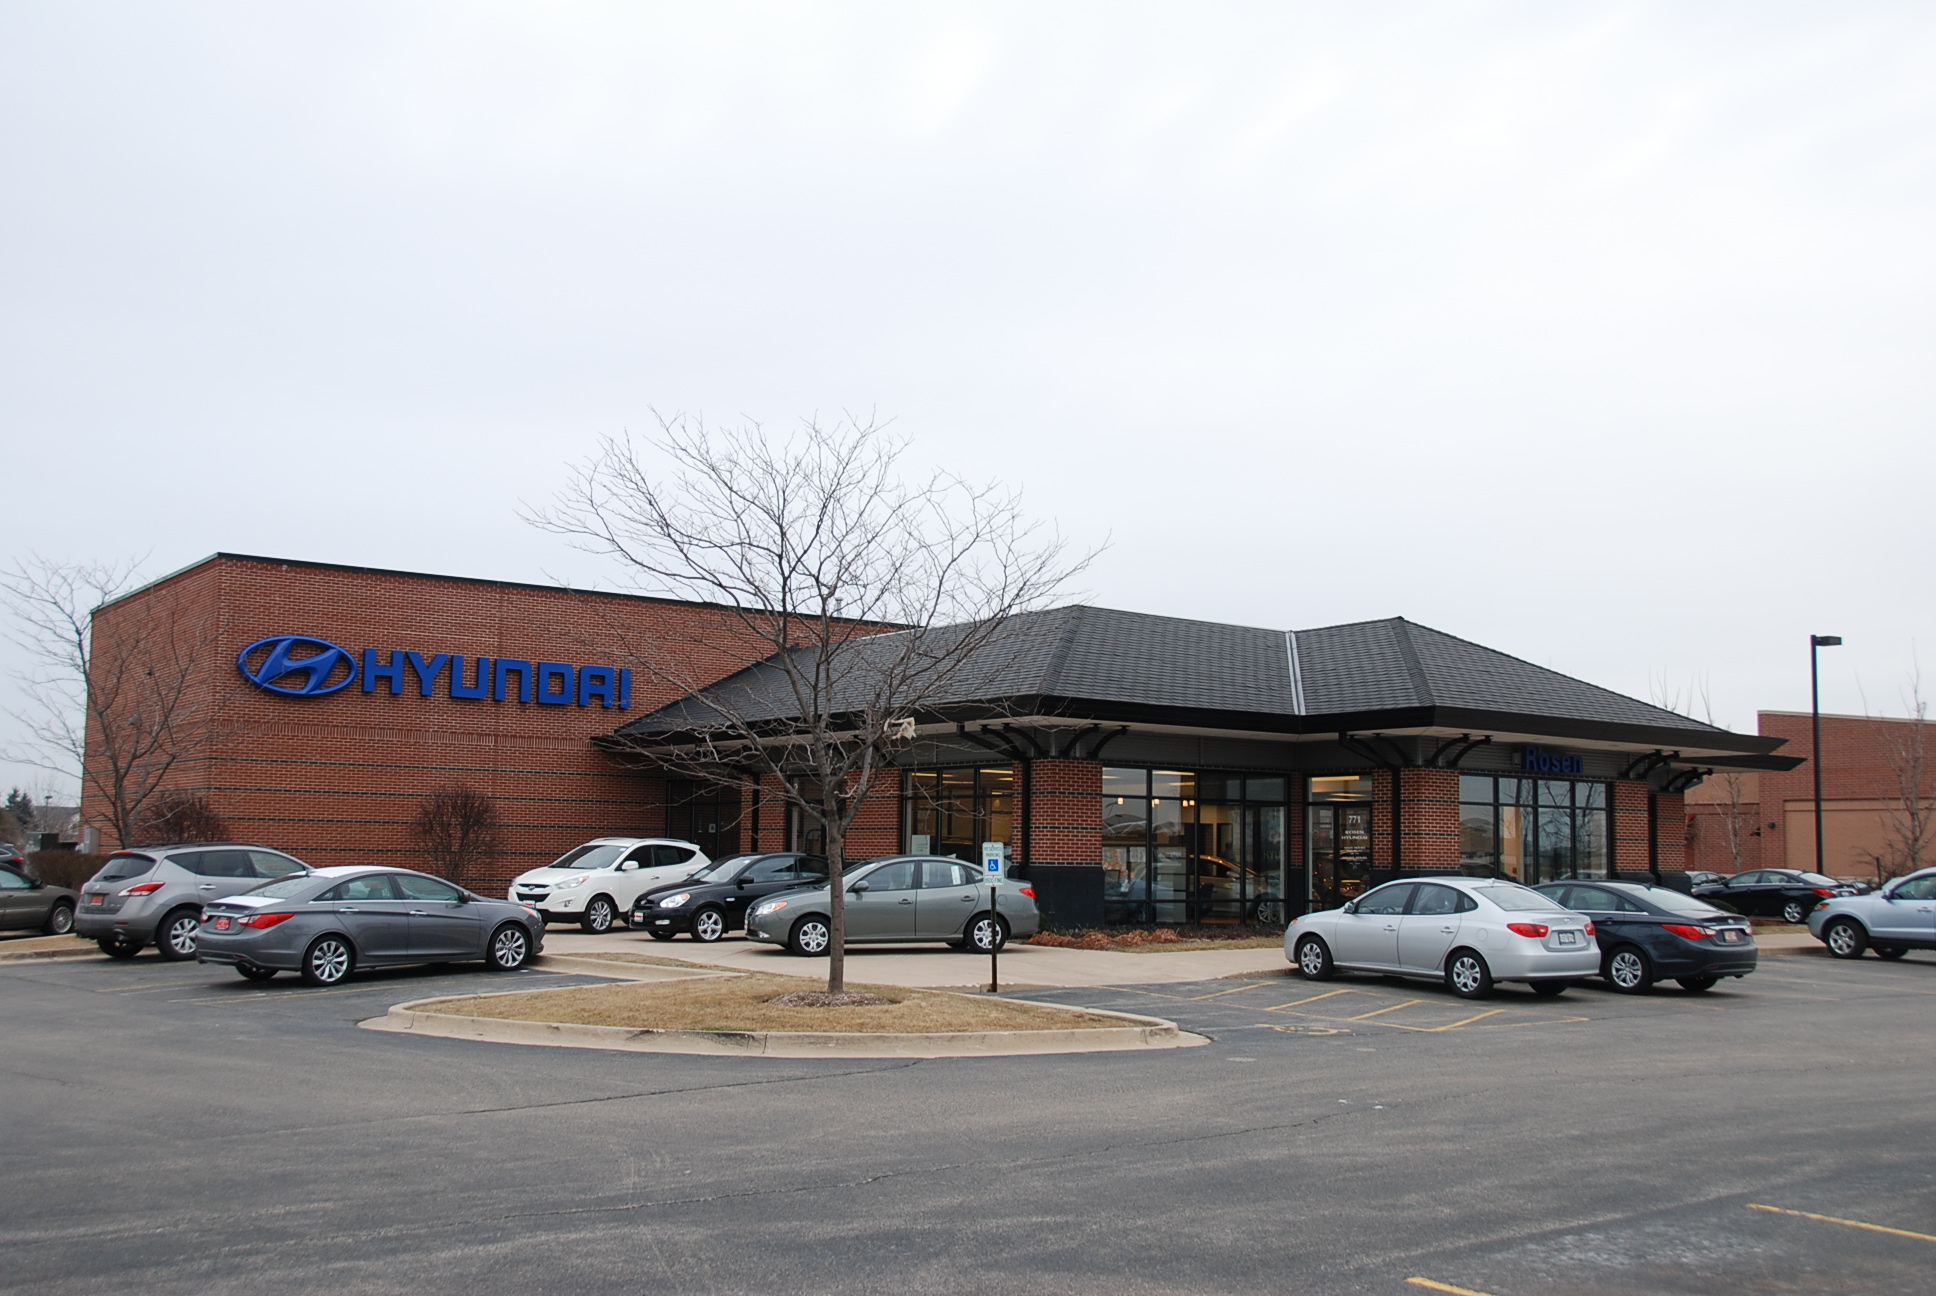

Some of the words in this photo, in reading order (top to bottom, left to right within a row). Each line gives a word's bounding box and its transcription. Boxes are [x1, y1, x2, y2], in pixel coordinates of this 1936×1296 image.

[362, 648, 632, 709] HYUNDAI
[1525, 744, 1584, 773] Rosen
[1348, 815, 1361, 824] 771
